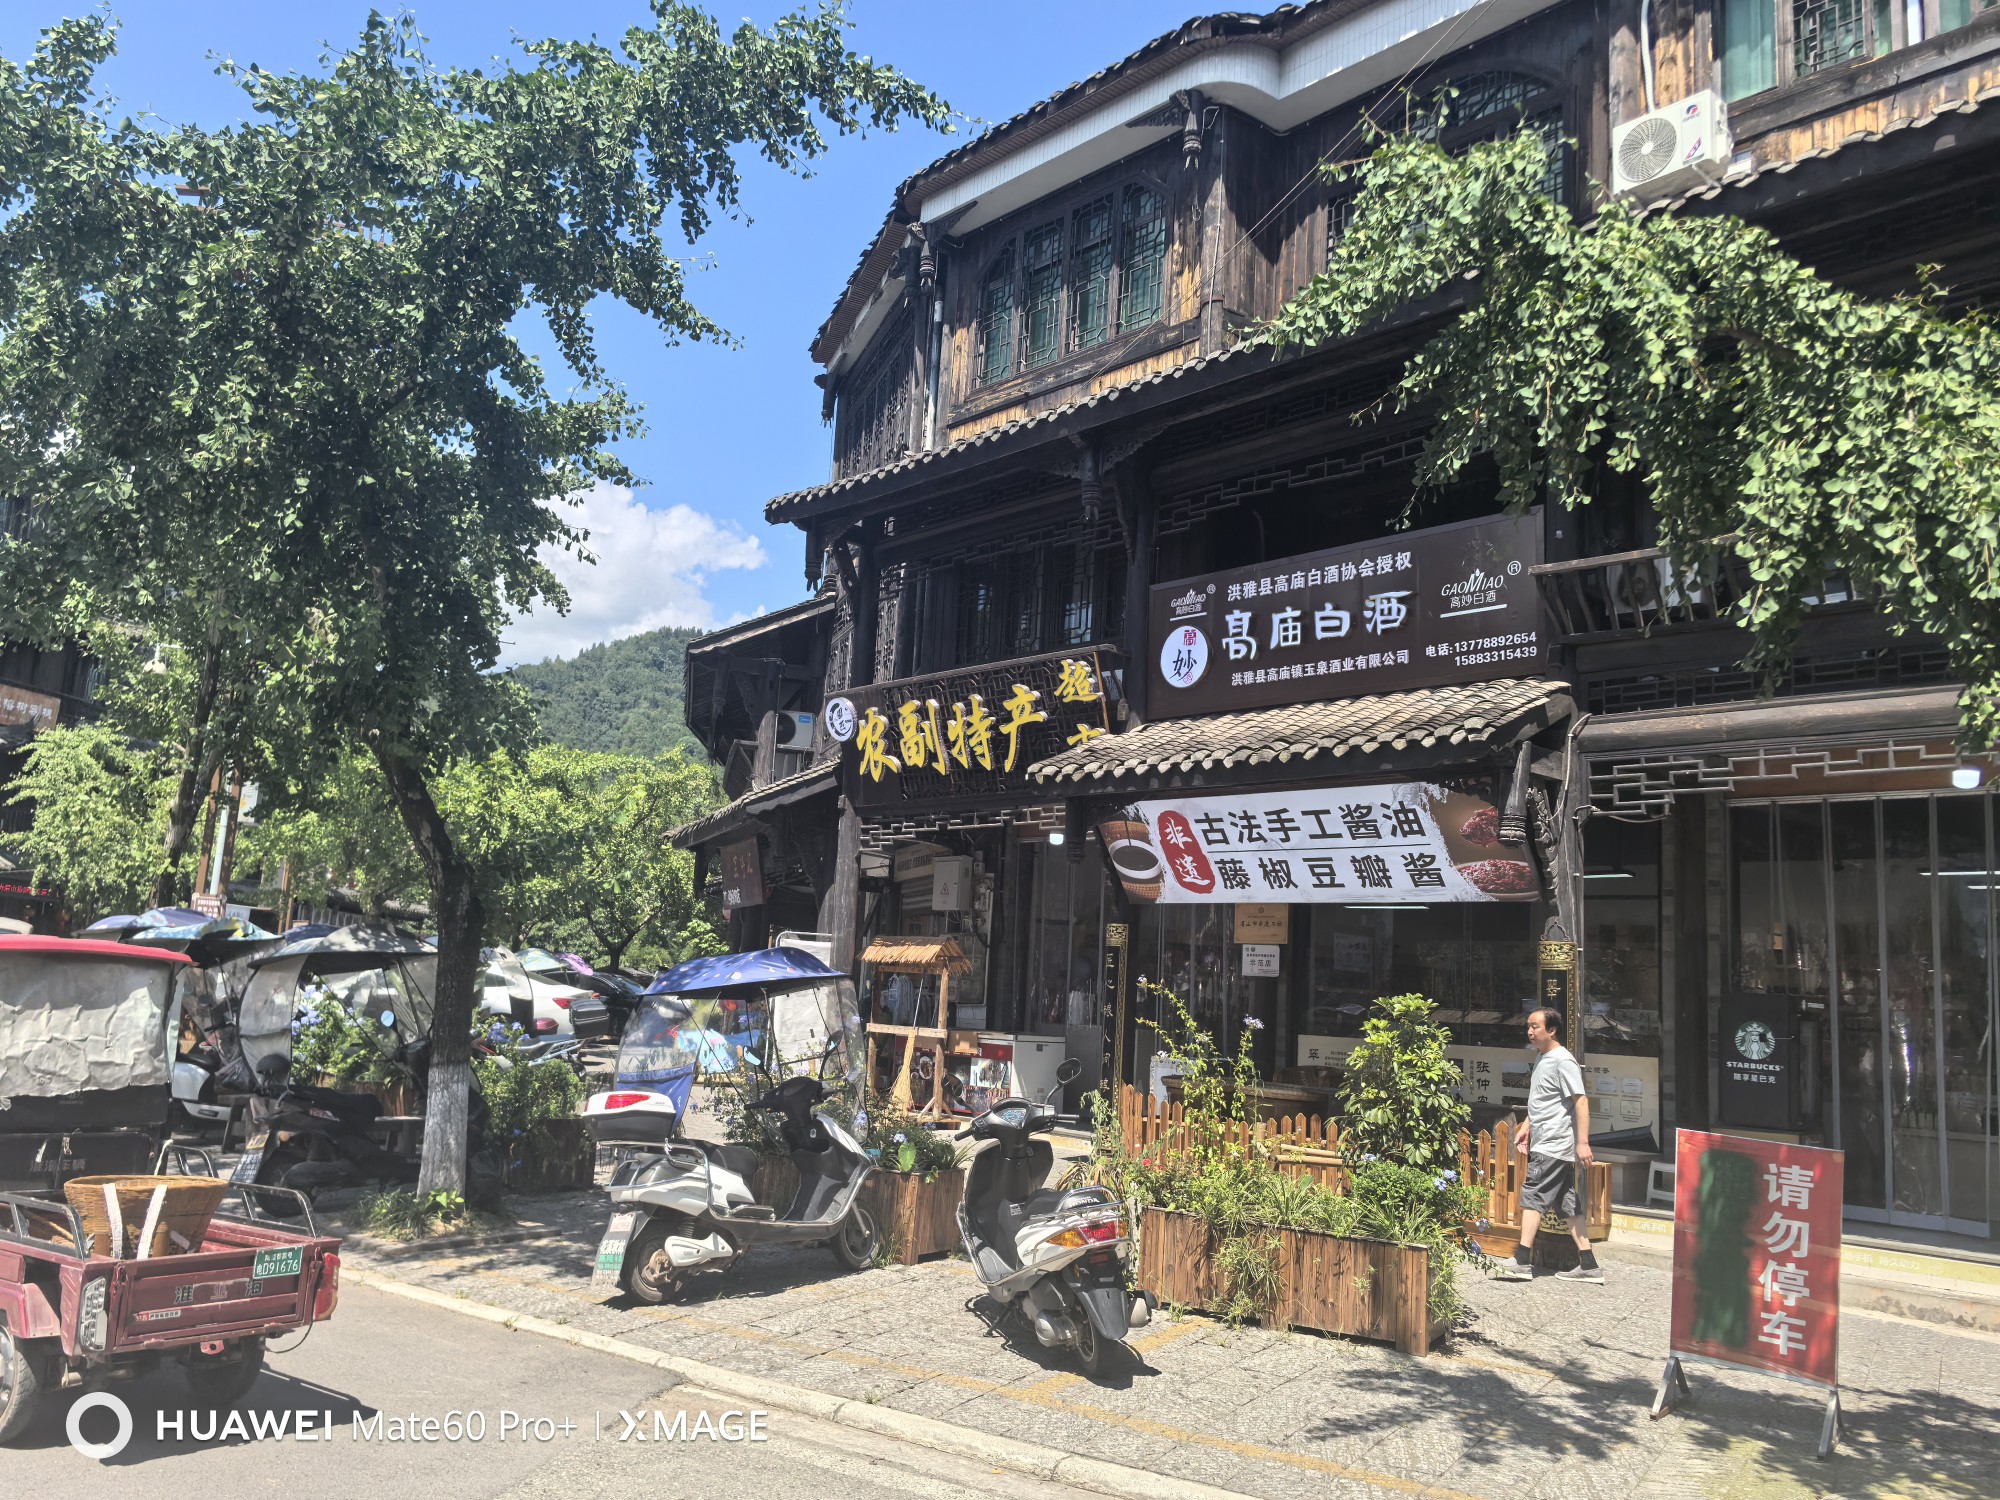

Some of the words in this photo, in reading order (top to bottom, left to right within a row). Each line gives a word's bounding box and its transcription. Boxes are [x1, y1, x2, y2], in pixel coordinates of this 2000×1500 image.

[1227, 551, 1412, 601] 洪雅县高庙白酒协会授权
[1231, 648, 1409, 686] 洪雅县高庙镇玉泉酒业有限公司
[1454, 646, 1537, 666] 15883315439
[857, 683, 1048, 783] 农副特产
[1194, 801, 1427, 847] 古法手工酱油
[1218, 852, 1447, 890] 藤椒豆瓣酱
[1726, 1061, 1781, 1071] STARBUCKS
[1758, 1163, 1814, 1356] 请勿停车
